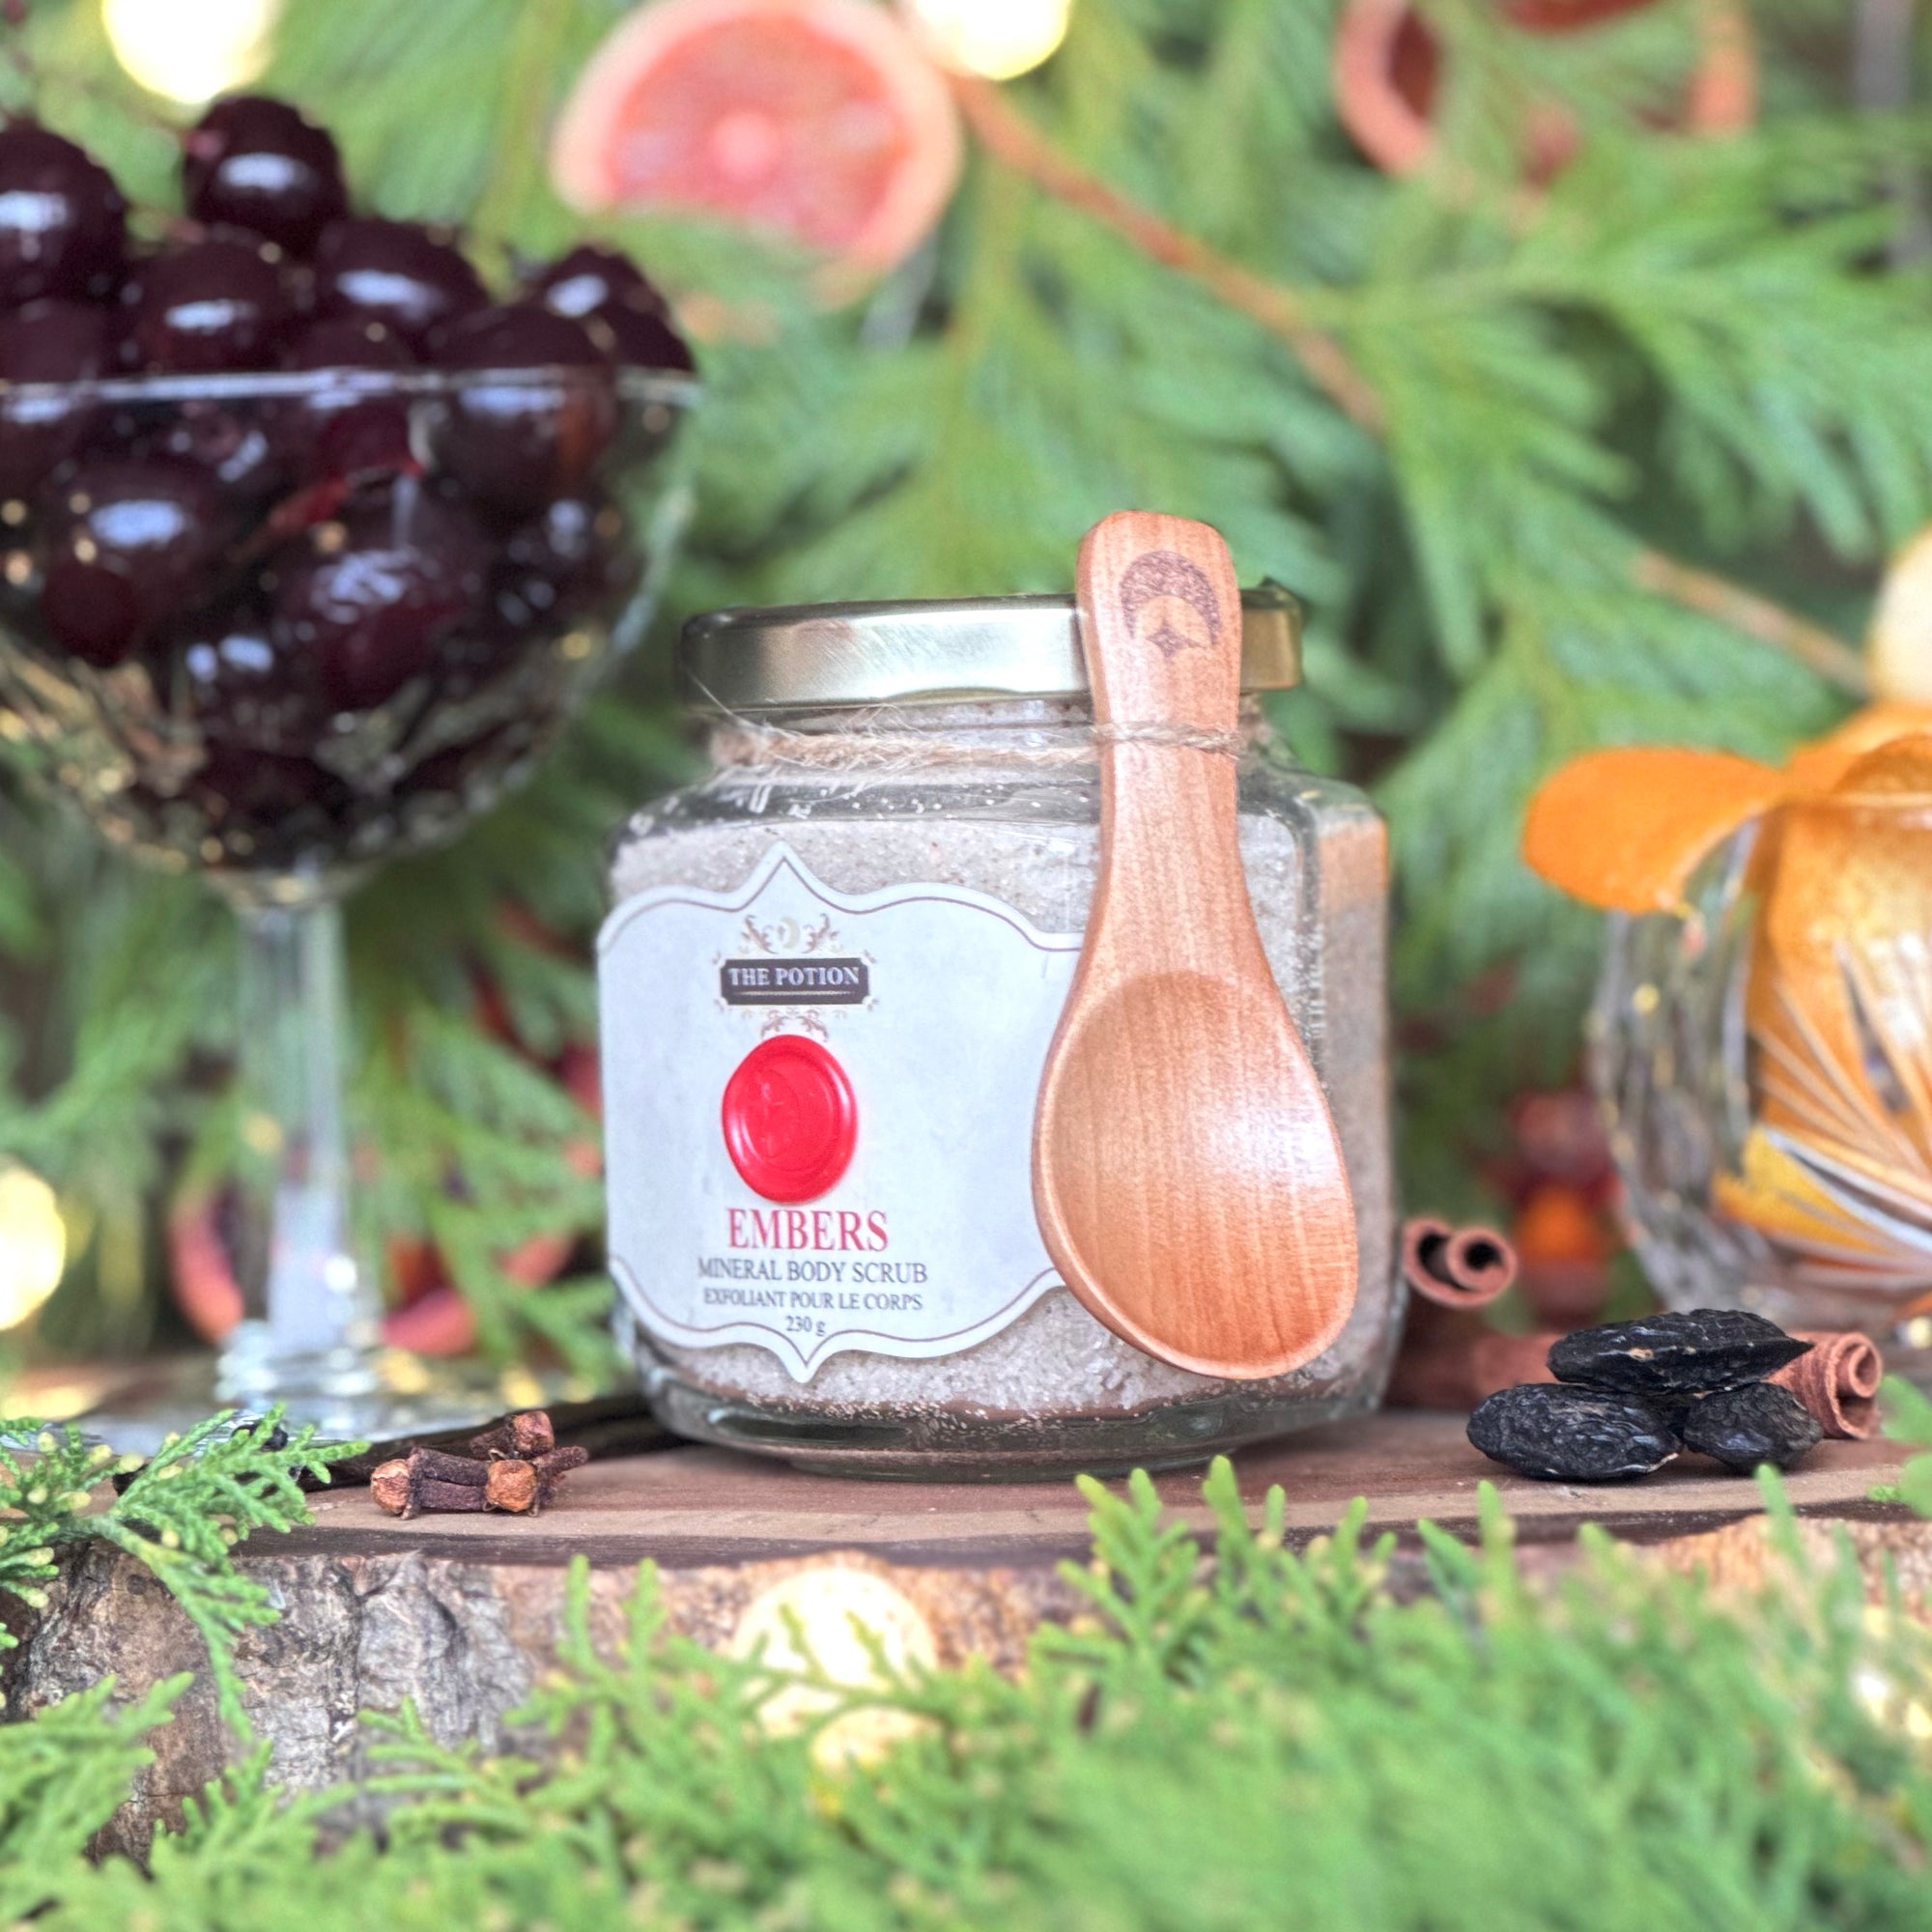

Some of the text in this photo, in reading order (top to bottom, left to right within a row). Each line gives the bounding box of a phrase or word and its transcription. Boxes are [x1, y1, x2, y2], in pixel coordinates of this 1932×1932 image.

[727, 966, 860, 986] THE POTION
[726, 1208, 889, 1252] EMBERS
[698, 1257, 927, 1284] MINERAL BODY SCRUB
[703, 1287, 923, 1311] EXFOLIANT POUR LE CORPS
[785, 1315, 827, 1336] 230 g
